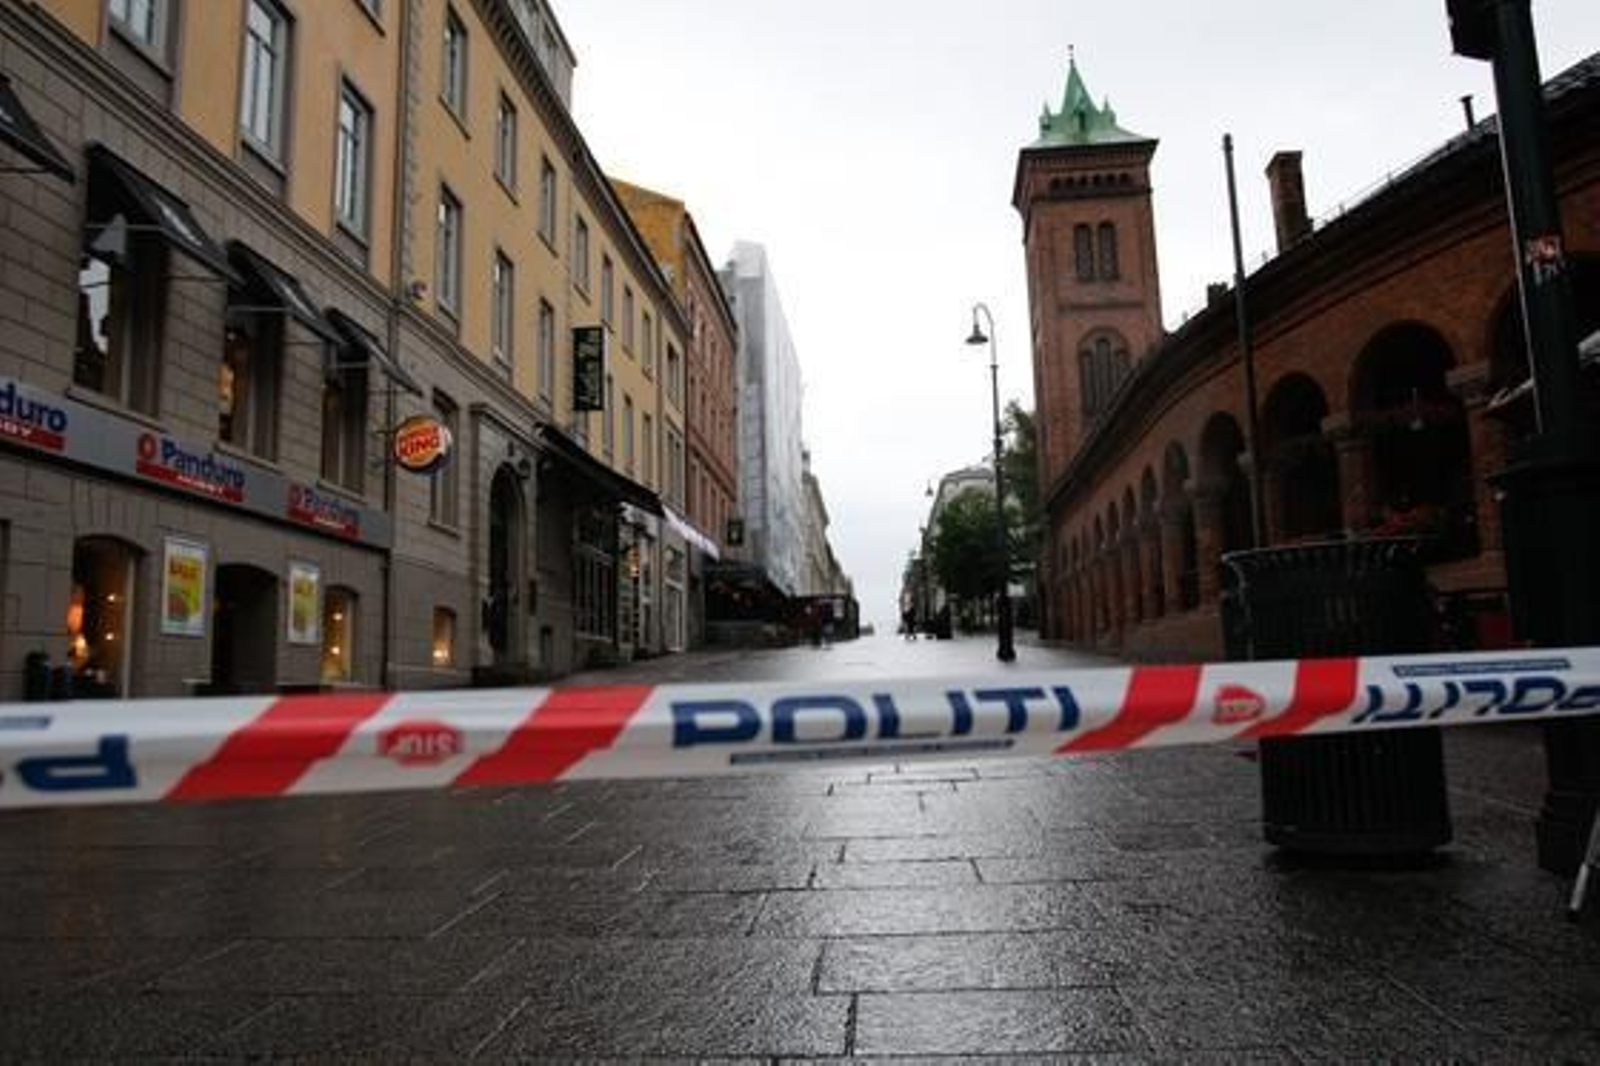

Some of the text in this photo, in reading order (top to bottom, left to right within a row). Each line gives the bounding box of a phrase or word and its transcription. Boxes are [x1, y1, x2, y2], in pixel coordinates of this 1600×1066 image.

[161, 438, 245, 488] Panduro
[671, 685, 1081, 748] POLITI
[0, 735, 137, 792] P
